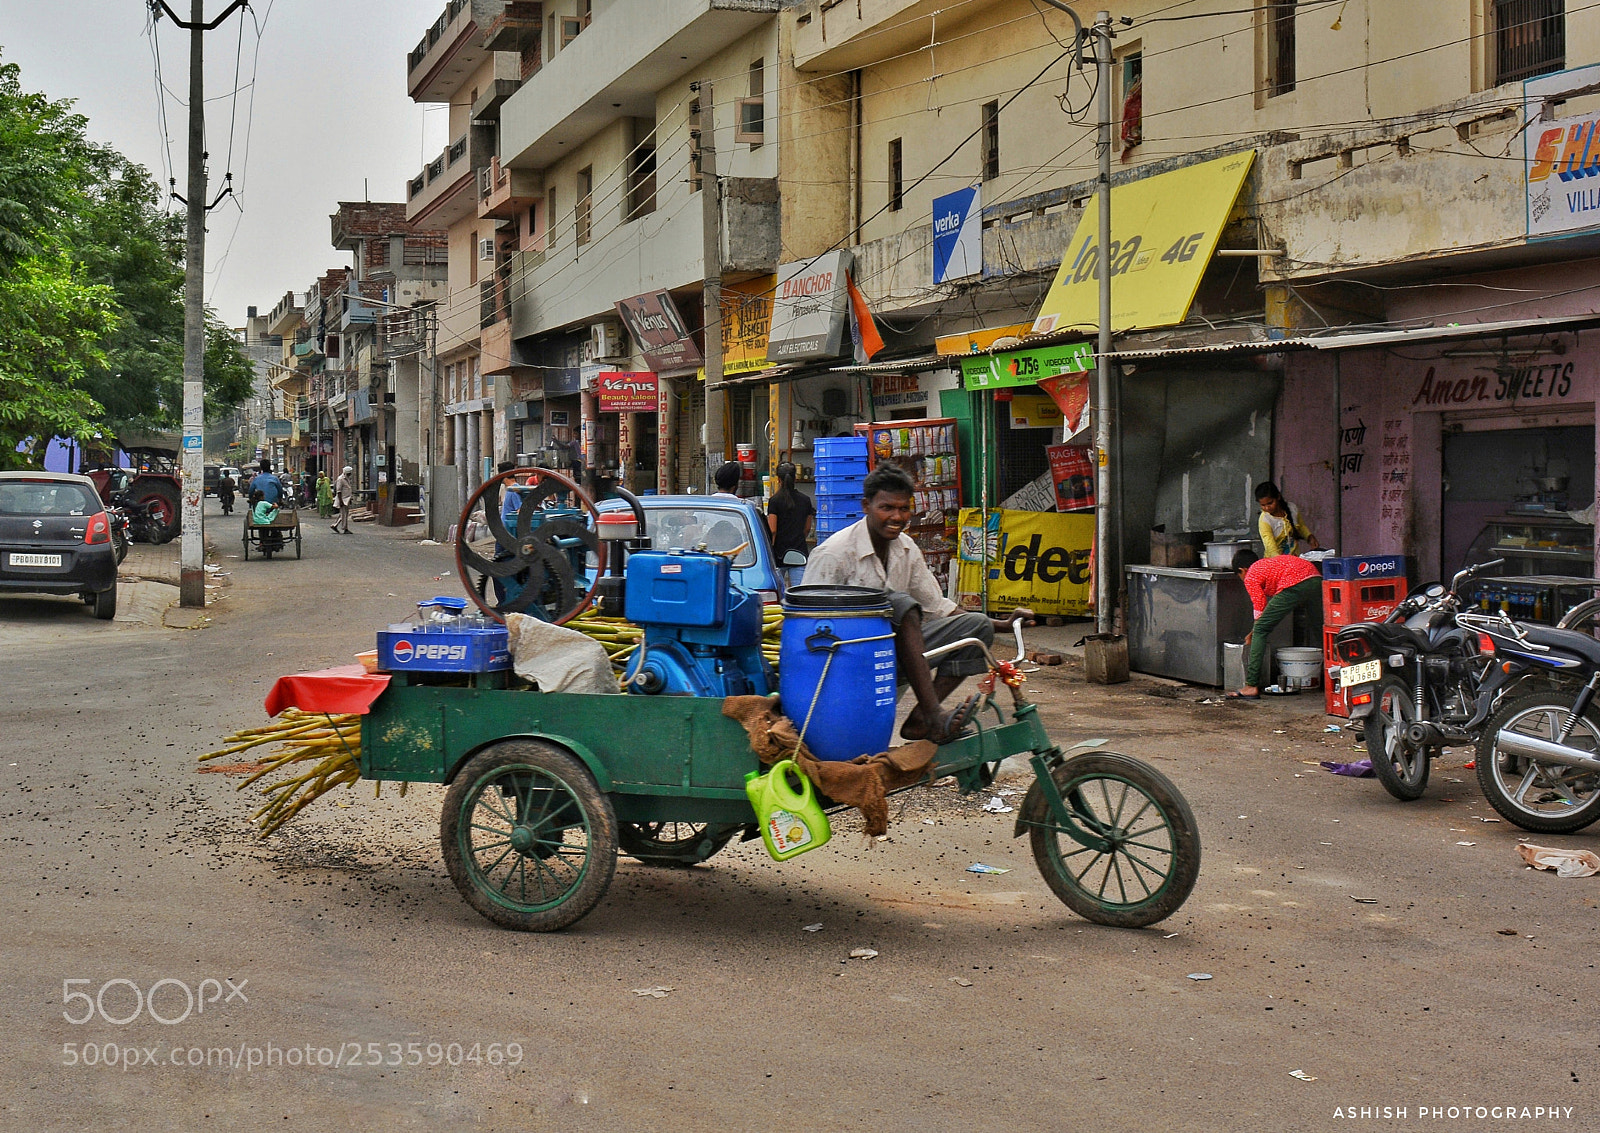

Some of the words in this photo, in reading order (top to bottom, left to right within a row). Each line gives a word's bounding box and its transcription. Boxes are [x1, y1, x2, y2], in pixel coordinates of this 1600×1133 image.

[935, 211, 960, 232] verka
[1160, 232, 1205, 264] 4G
[791, 272, 833, 297] ANCHOR
[965, 366, 991, 375] VIDEOCON
[1015, 357, 1039, 376] 2.75G
[1043, 356, 1075, 367] VIDEOCON
[1495, 361, 1574, 401] SWEETS
[1050, 449, 1076, 460] RAGE
[1370, 561, 1396, 573] pepsi
[414, 644, 467, 660] PEPSI
